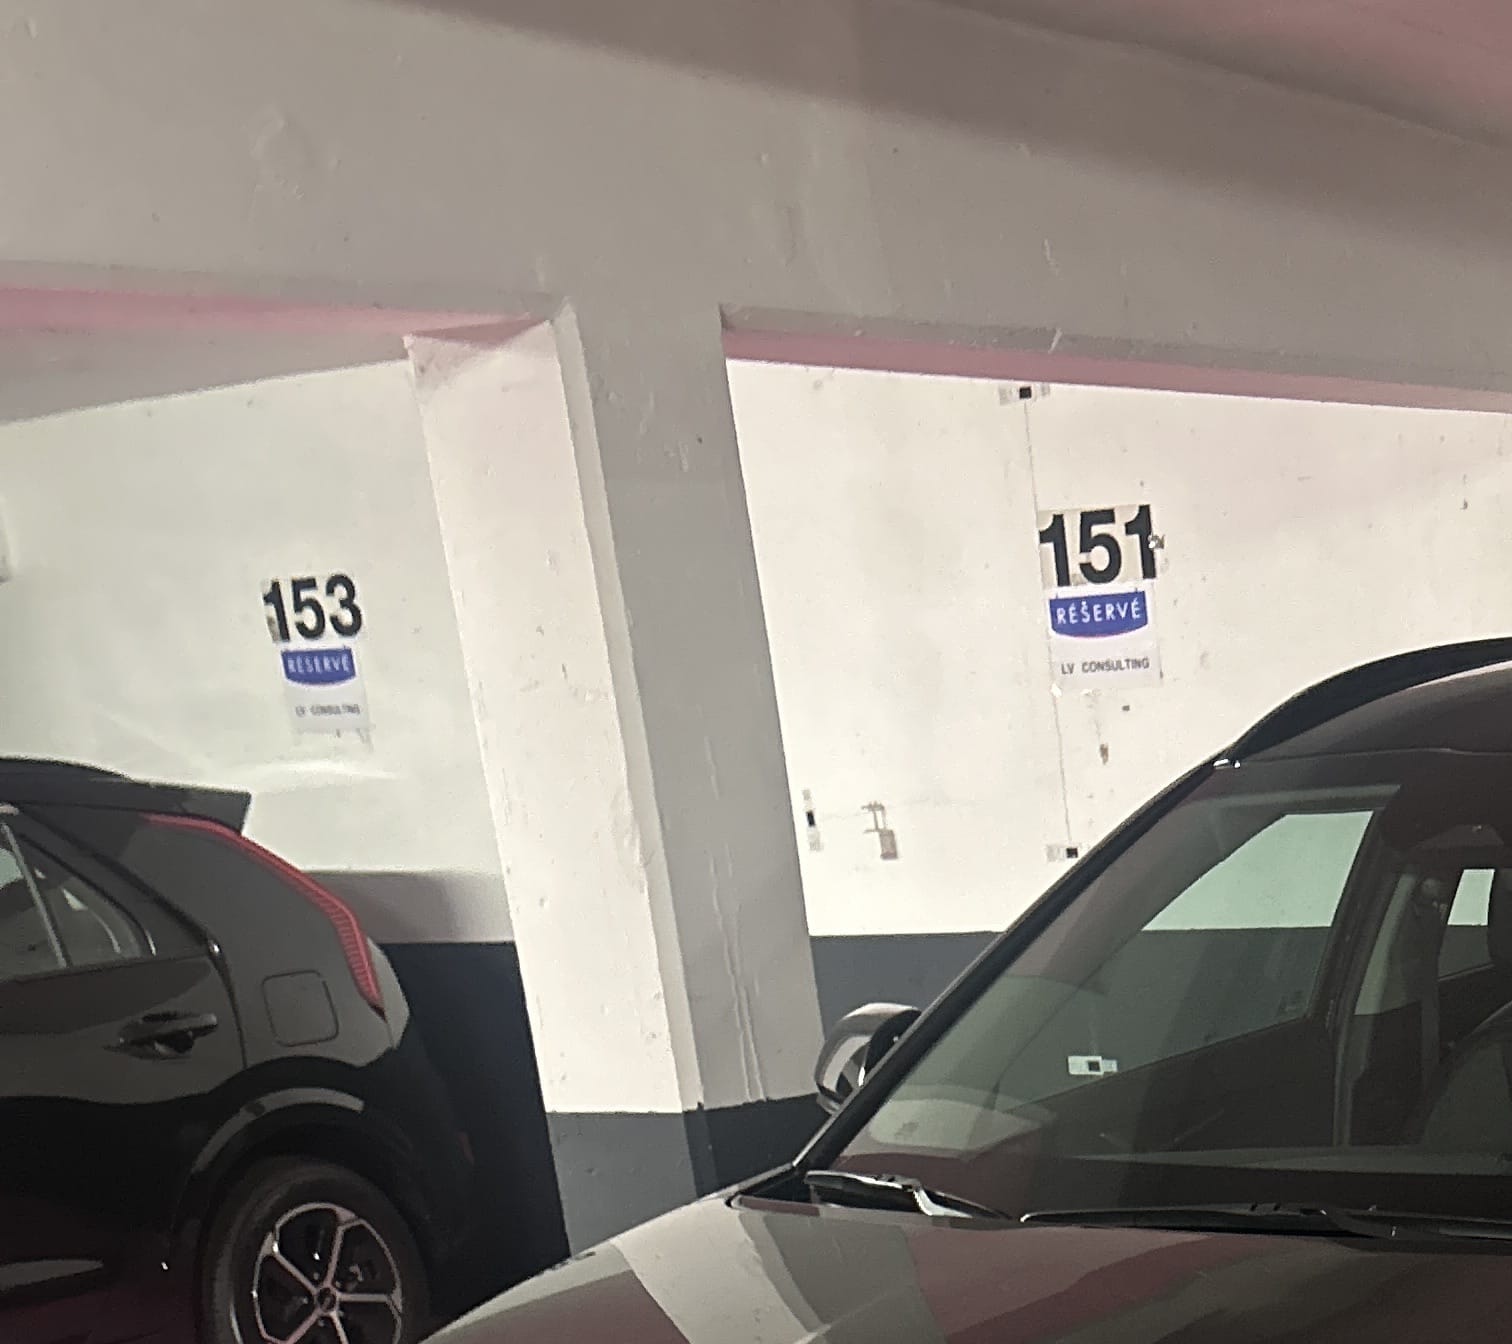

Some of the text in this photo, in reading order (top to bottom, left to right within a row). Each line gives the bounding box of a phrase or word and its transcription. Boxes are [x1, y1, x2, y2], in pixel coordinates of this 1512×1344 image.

[1039, 504, 1156, 587] 151
[263, 573, 362, 642] 153
[1056, 598, 1142, 624] RÉSERVÉ
[1061, 657, 1150, 675] LV CONSULTING
